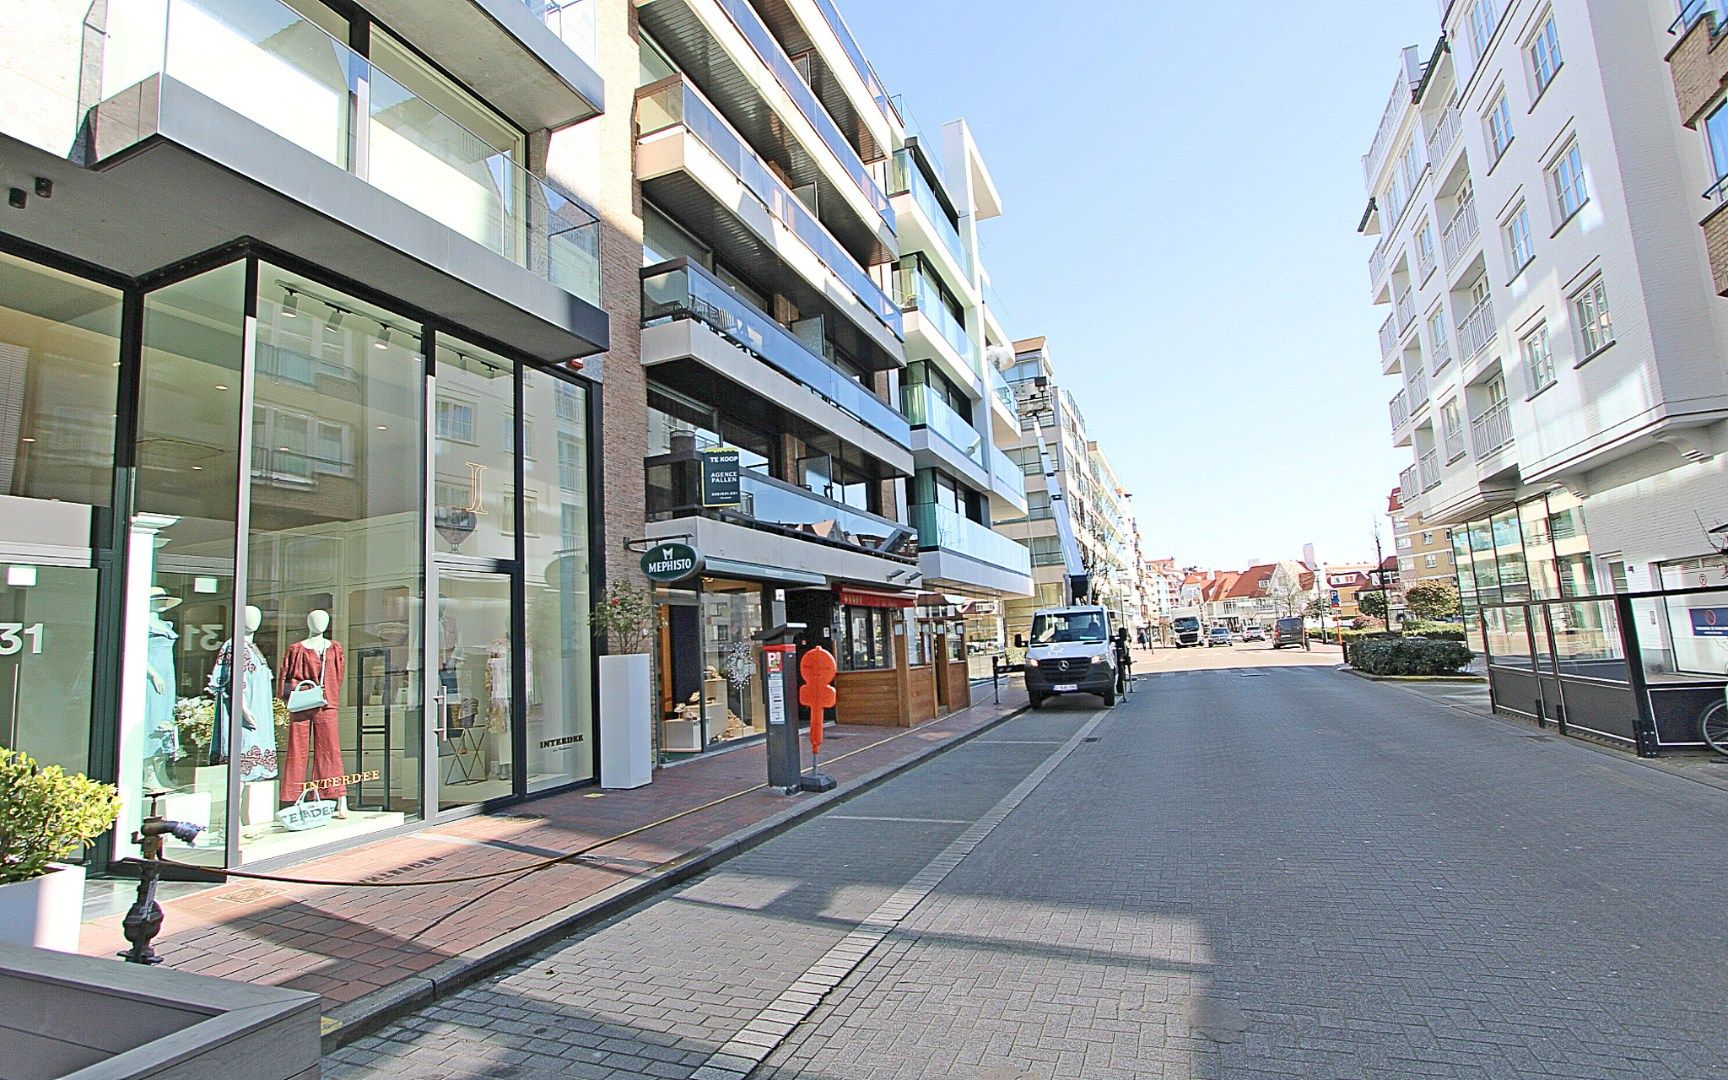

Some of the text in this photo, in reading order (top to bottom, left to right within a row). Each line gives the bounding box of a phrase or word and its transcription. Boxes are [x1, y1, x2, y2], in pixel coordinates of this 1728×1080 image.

[648, 558, 692, 573] MEPHISTO
[0, 622, 44, 655] 31
[540, 734, 584, 749] INTERDEE
[301, 769, 380, 791] INTERDEE
